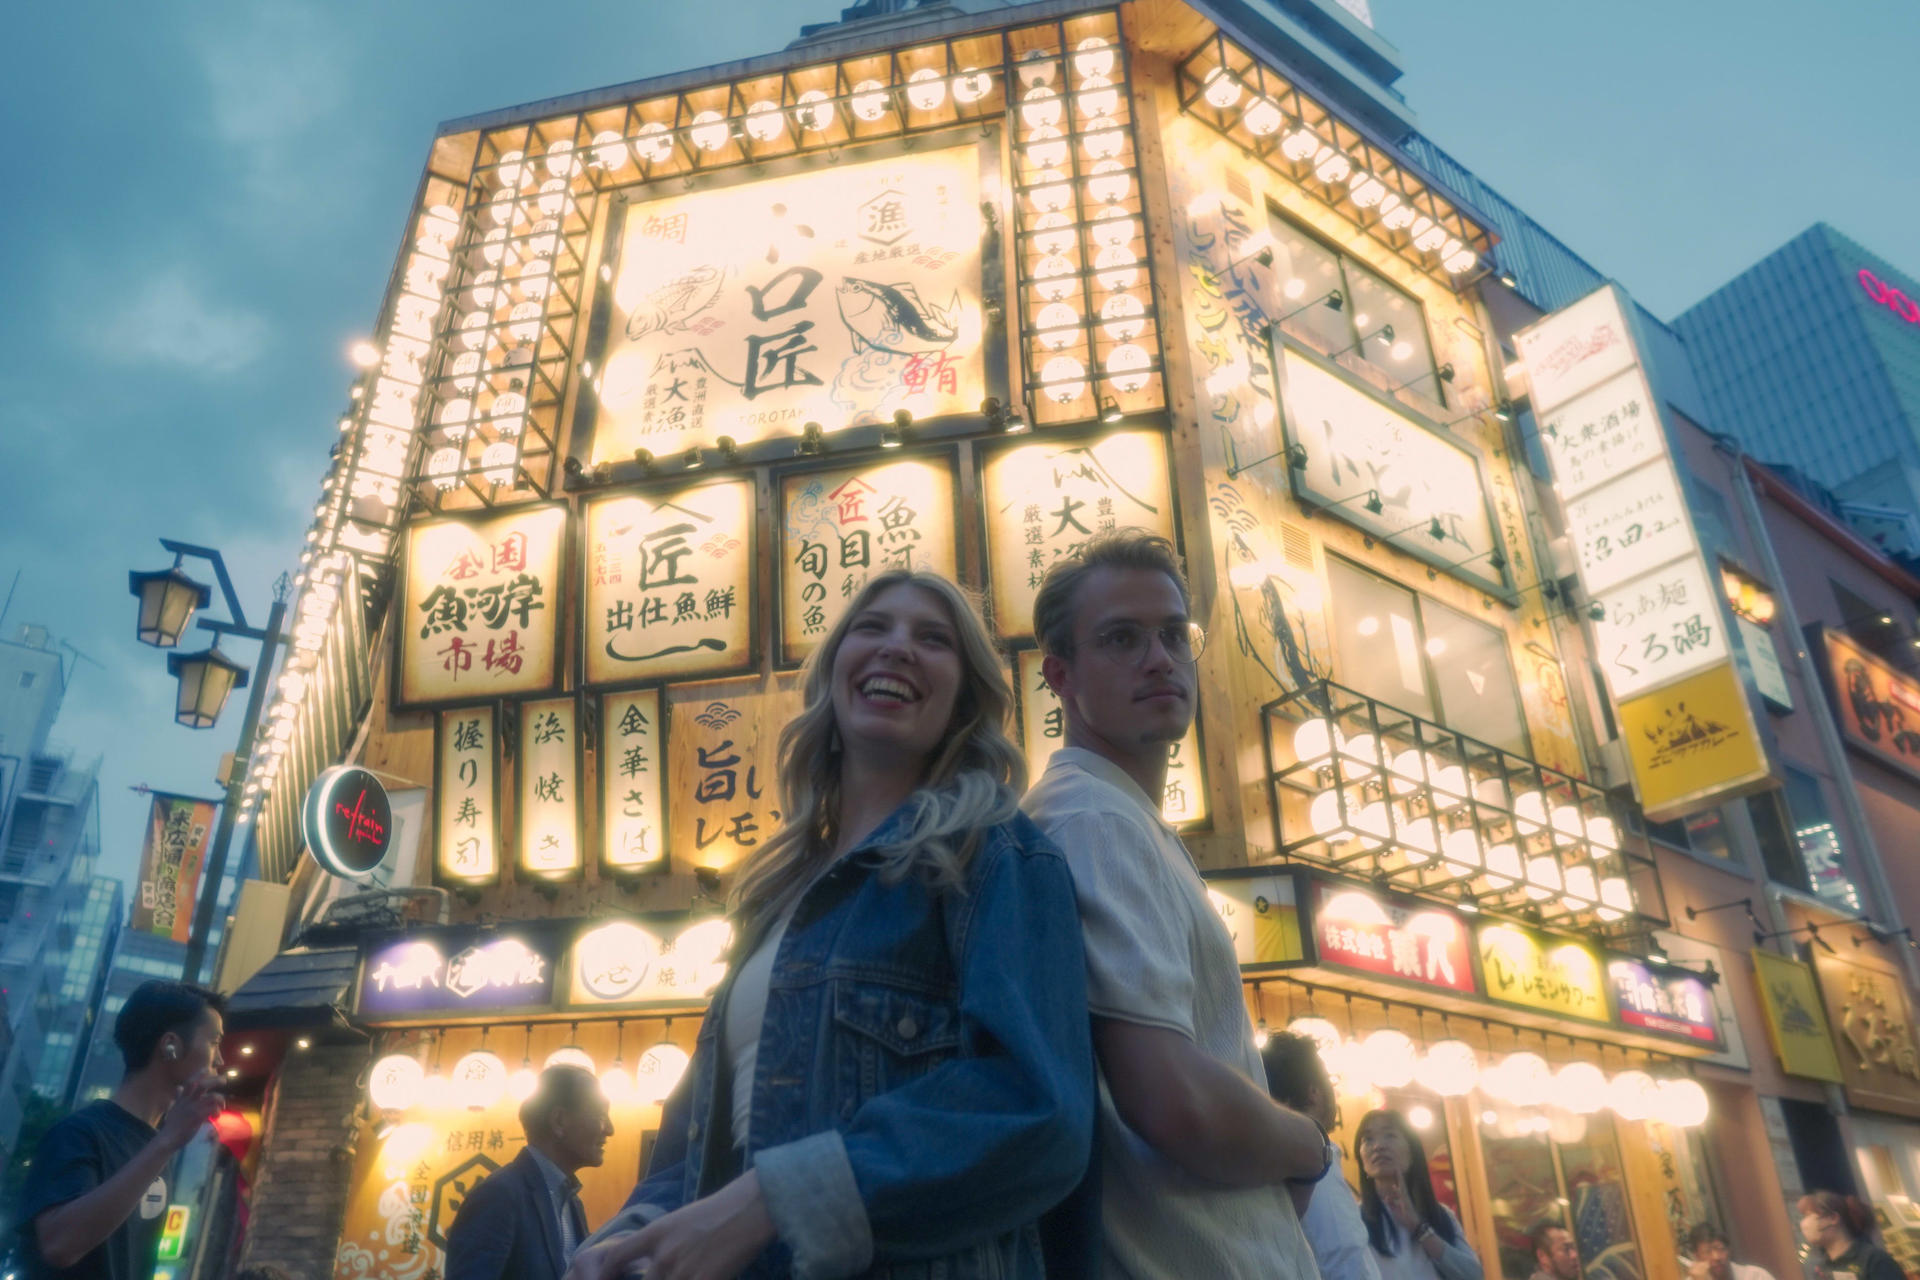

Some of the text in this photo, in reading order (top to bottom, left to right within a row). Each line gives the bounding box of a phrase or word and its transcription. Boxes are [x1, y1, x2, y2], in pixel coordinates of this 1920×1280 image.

[418, 572, 545, 640] 魚河岸
[795, 538, 829, 637] 旬の魚
[1612, 577, 1690, 629] らあ麺
[436, 629, 525, 683] 市場
[453, 718, 484, 868] 握り寿司
[534, 711, 566, 863] 浜焼き
[694, 809, 781, 851] レモ
[1520, 972, 1598, 1005] レモンサワー
[447, 1129, 527, 1151] 信用第一
